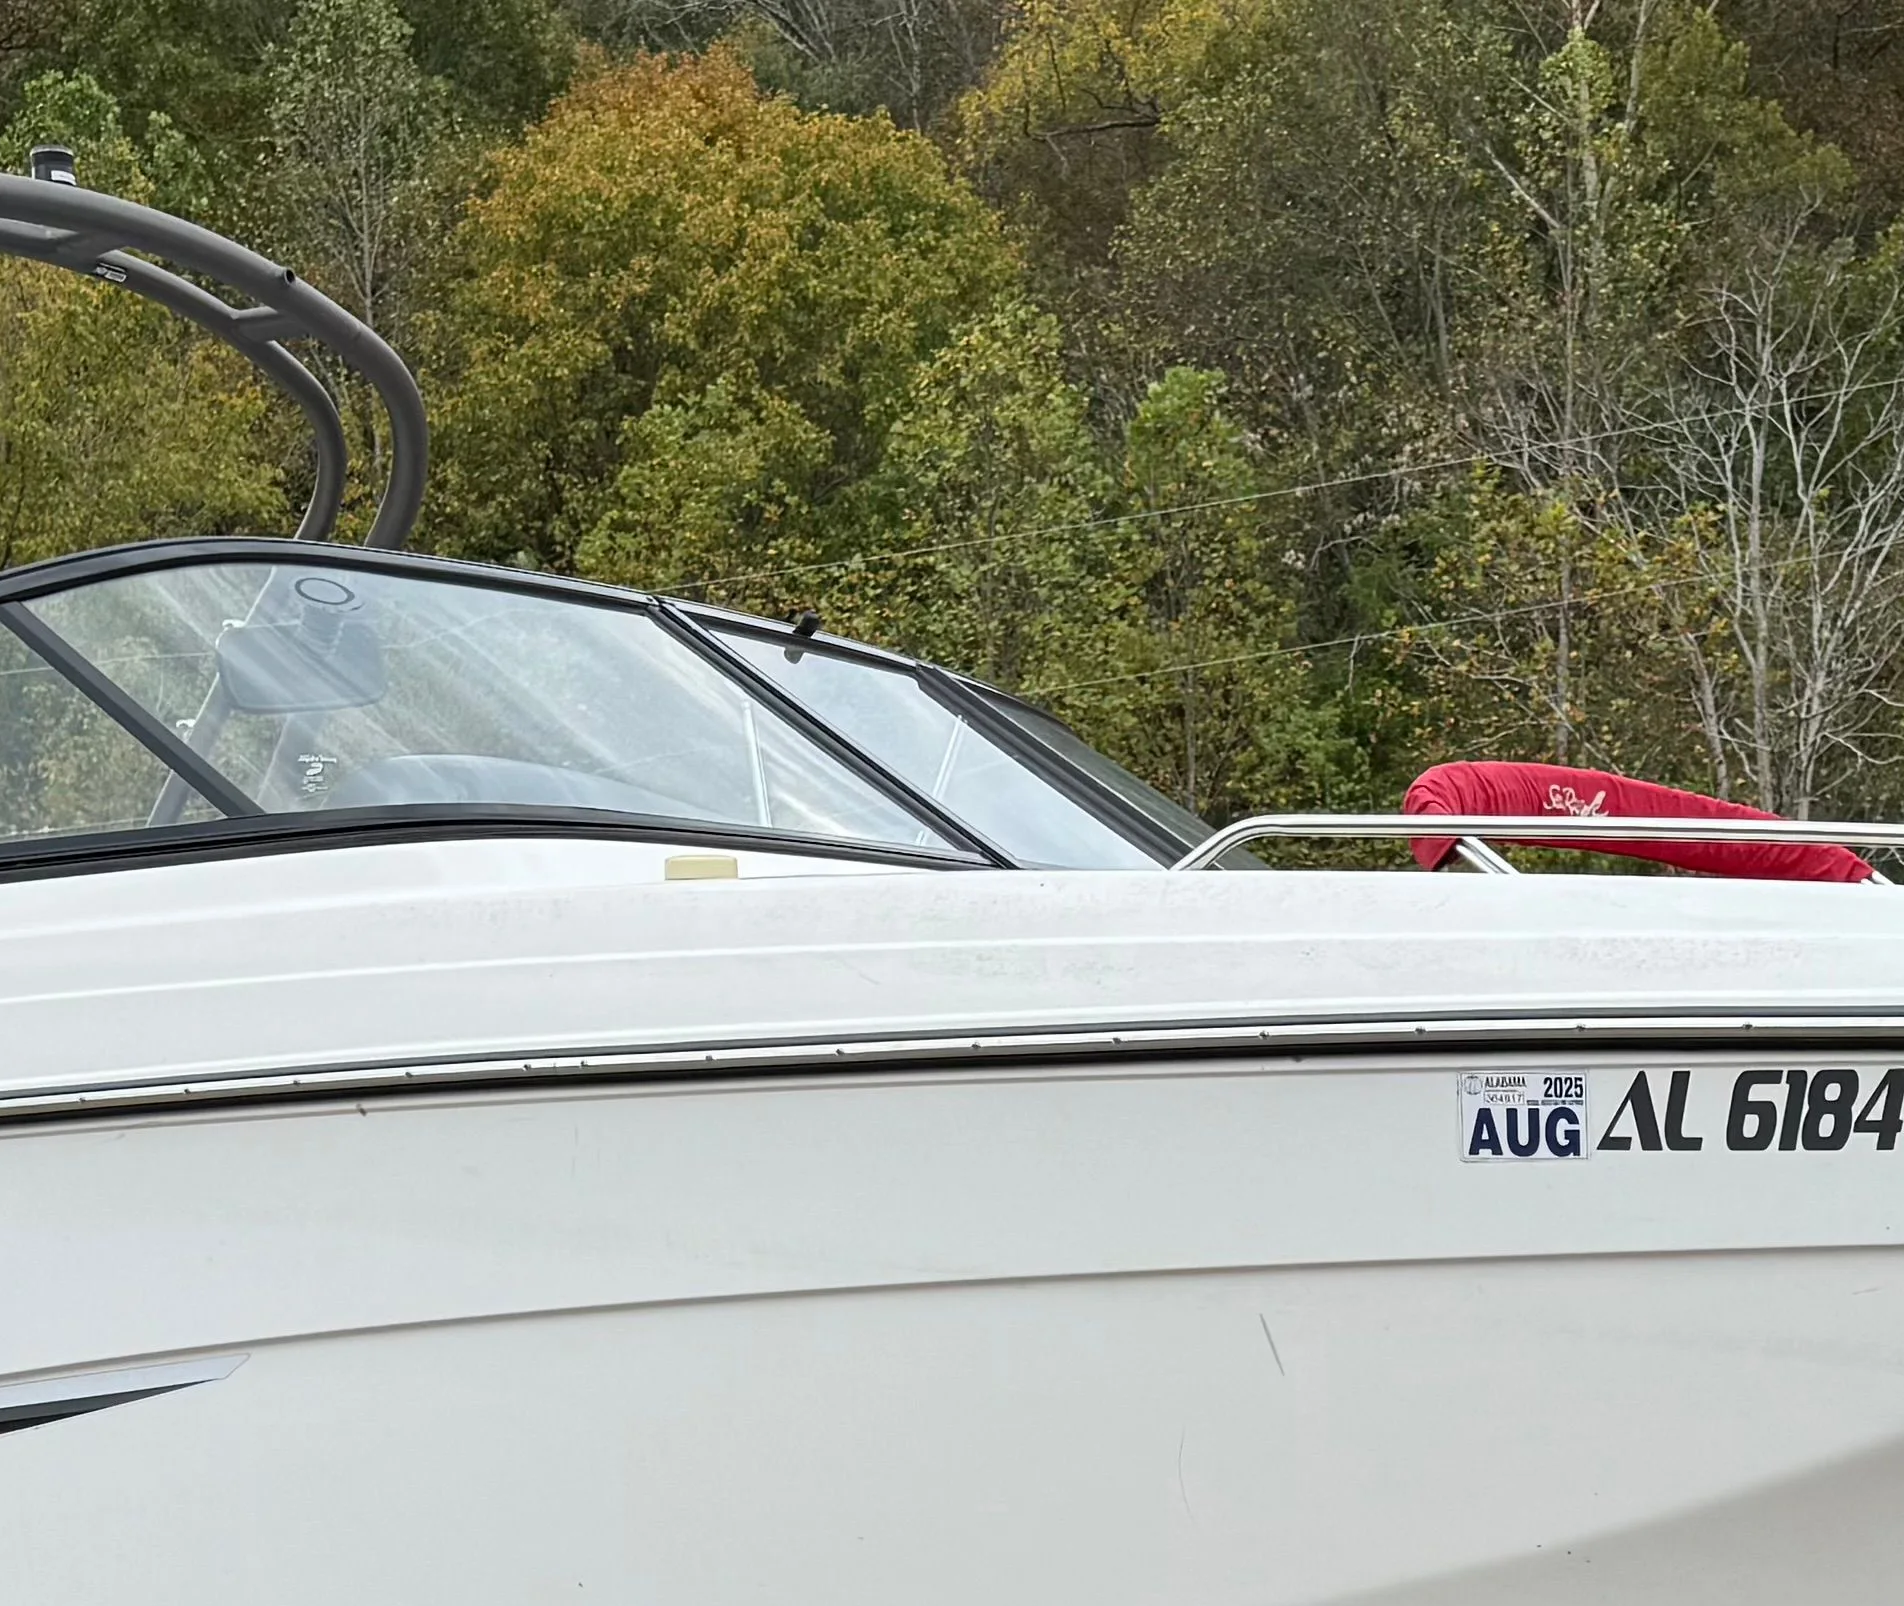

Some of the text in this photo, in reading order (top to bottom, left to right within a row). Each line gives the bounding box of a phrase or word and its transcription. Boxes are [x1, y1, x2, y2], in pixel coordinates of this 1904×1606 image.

[1543, 1076, 1584, 1098] 2025
[1598, 1070, 1703, 1151] AL
[1469, 1107, 1581, 1157] AUG
